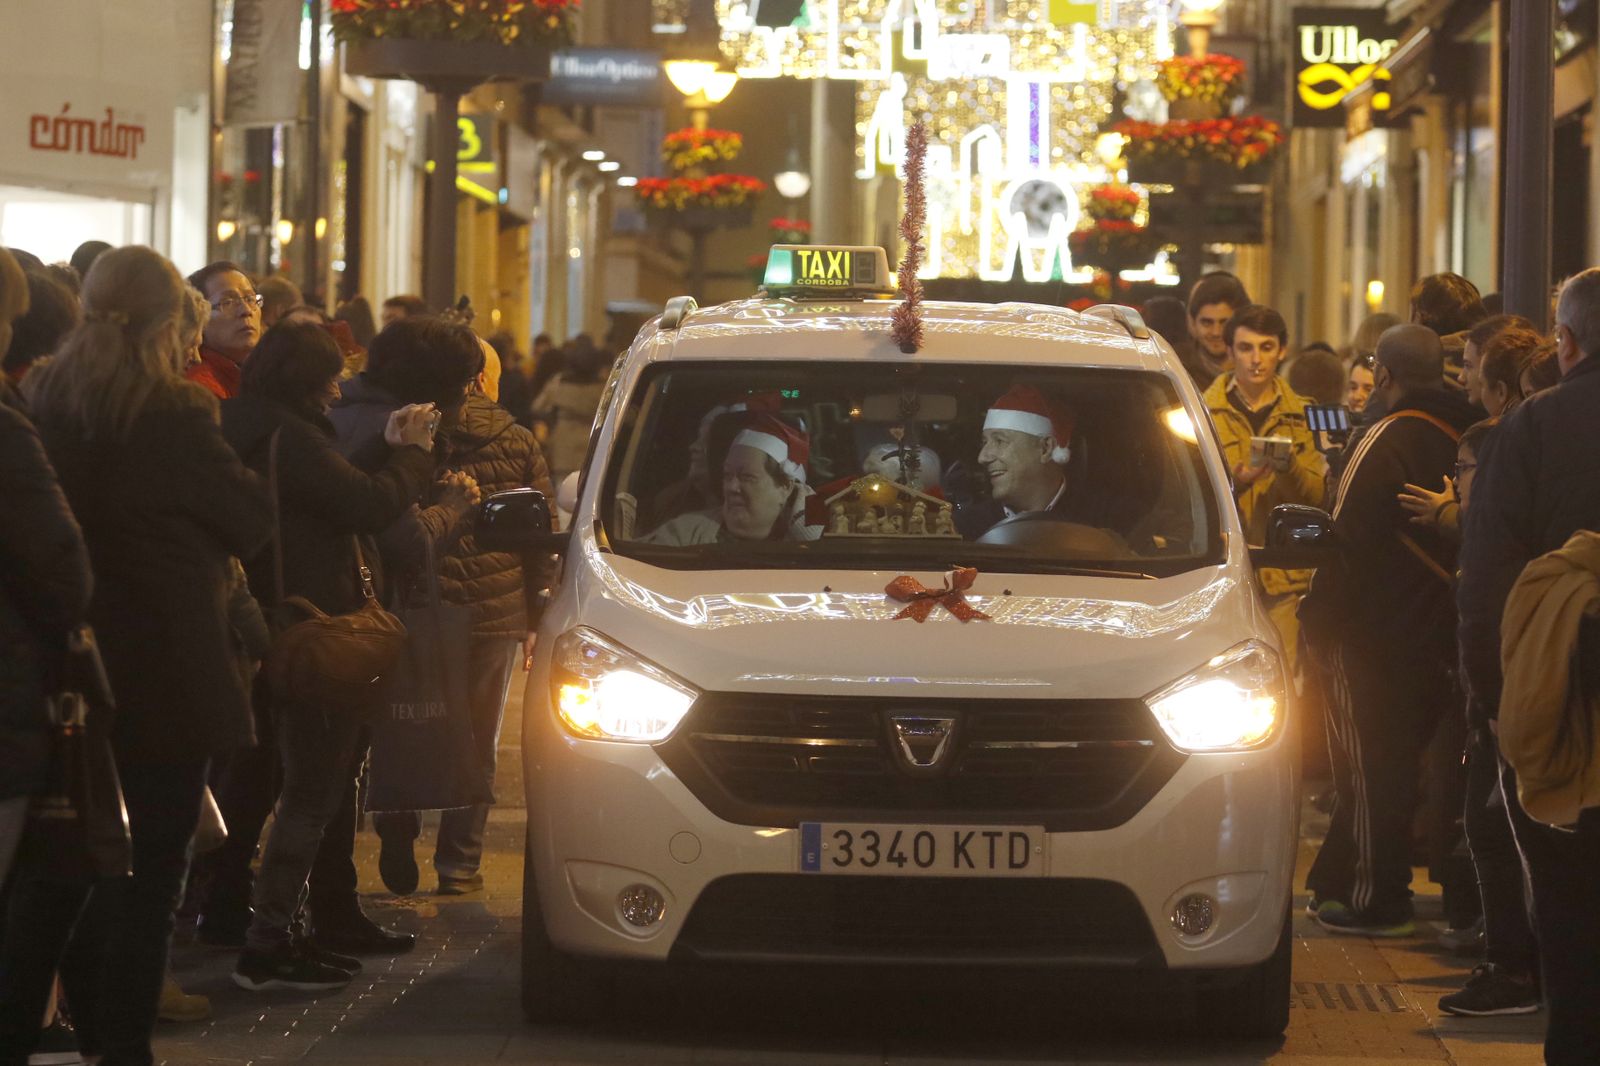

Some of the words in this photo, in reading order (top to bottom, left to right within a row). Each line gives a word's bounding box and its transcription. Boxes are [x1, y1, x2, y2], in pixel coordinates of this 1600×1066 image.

[30, 102, 145, 160] cóndor
[797, 250, 851, 279] TAXI
[796, 278, 849, 286] CORDOBA
[832, 830, 936, 868] 3340
[953, 831, 1030, 869] KTD
